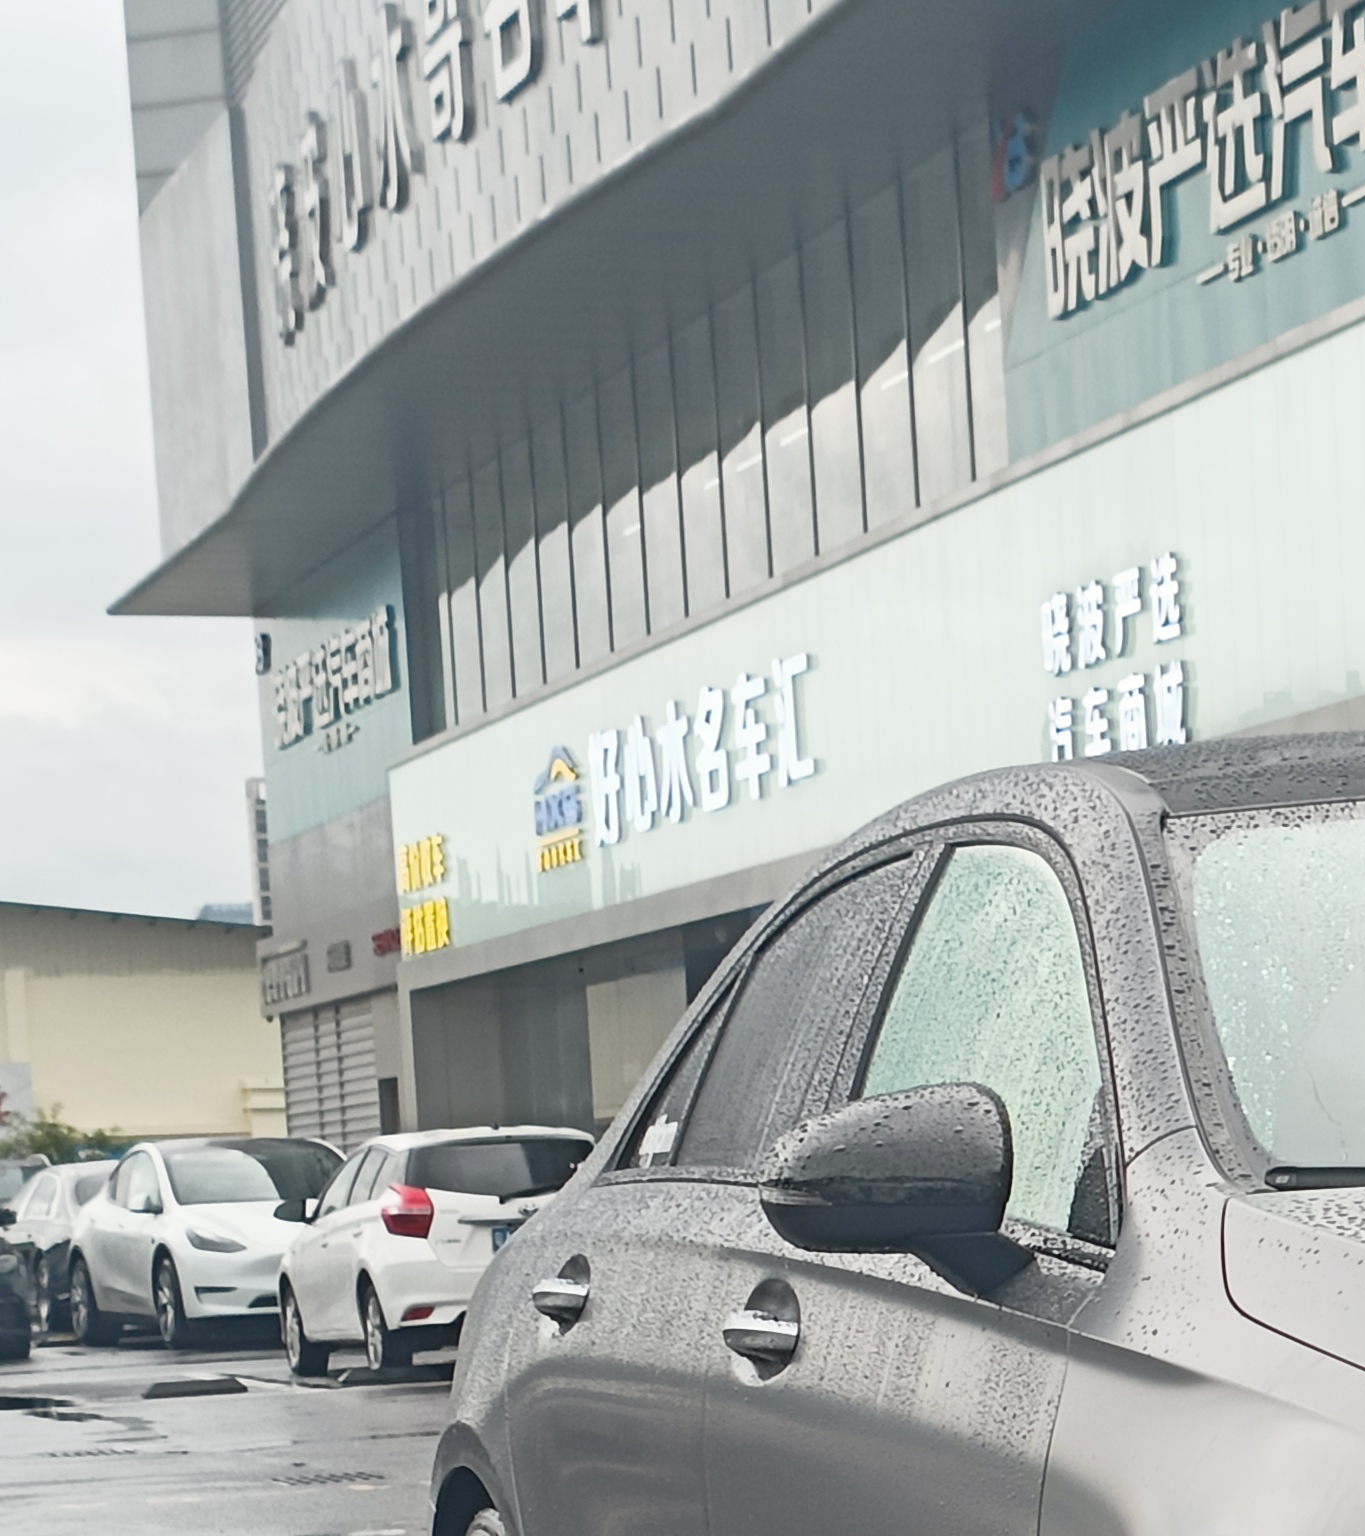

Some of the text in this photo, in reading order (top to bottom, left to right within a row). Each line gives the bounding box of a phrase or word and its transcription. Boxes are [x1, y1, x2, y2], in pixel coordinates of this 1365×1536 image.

[1041, 551, 1183, 677] 晓波严选
[588, 652, 816, 847] 好心水名车汇
